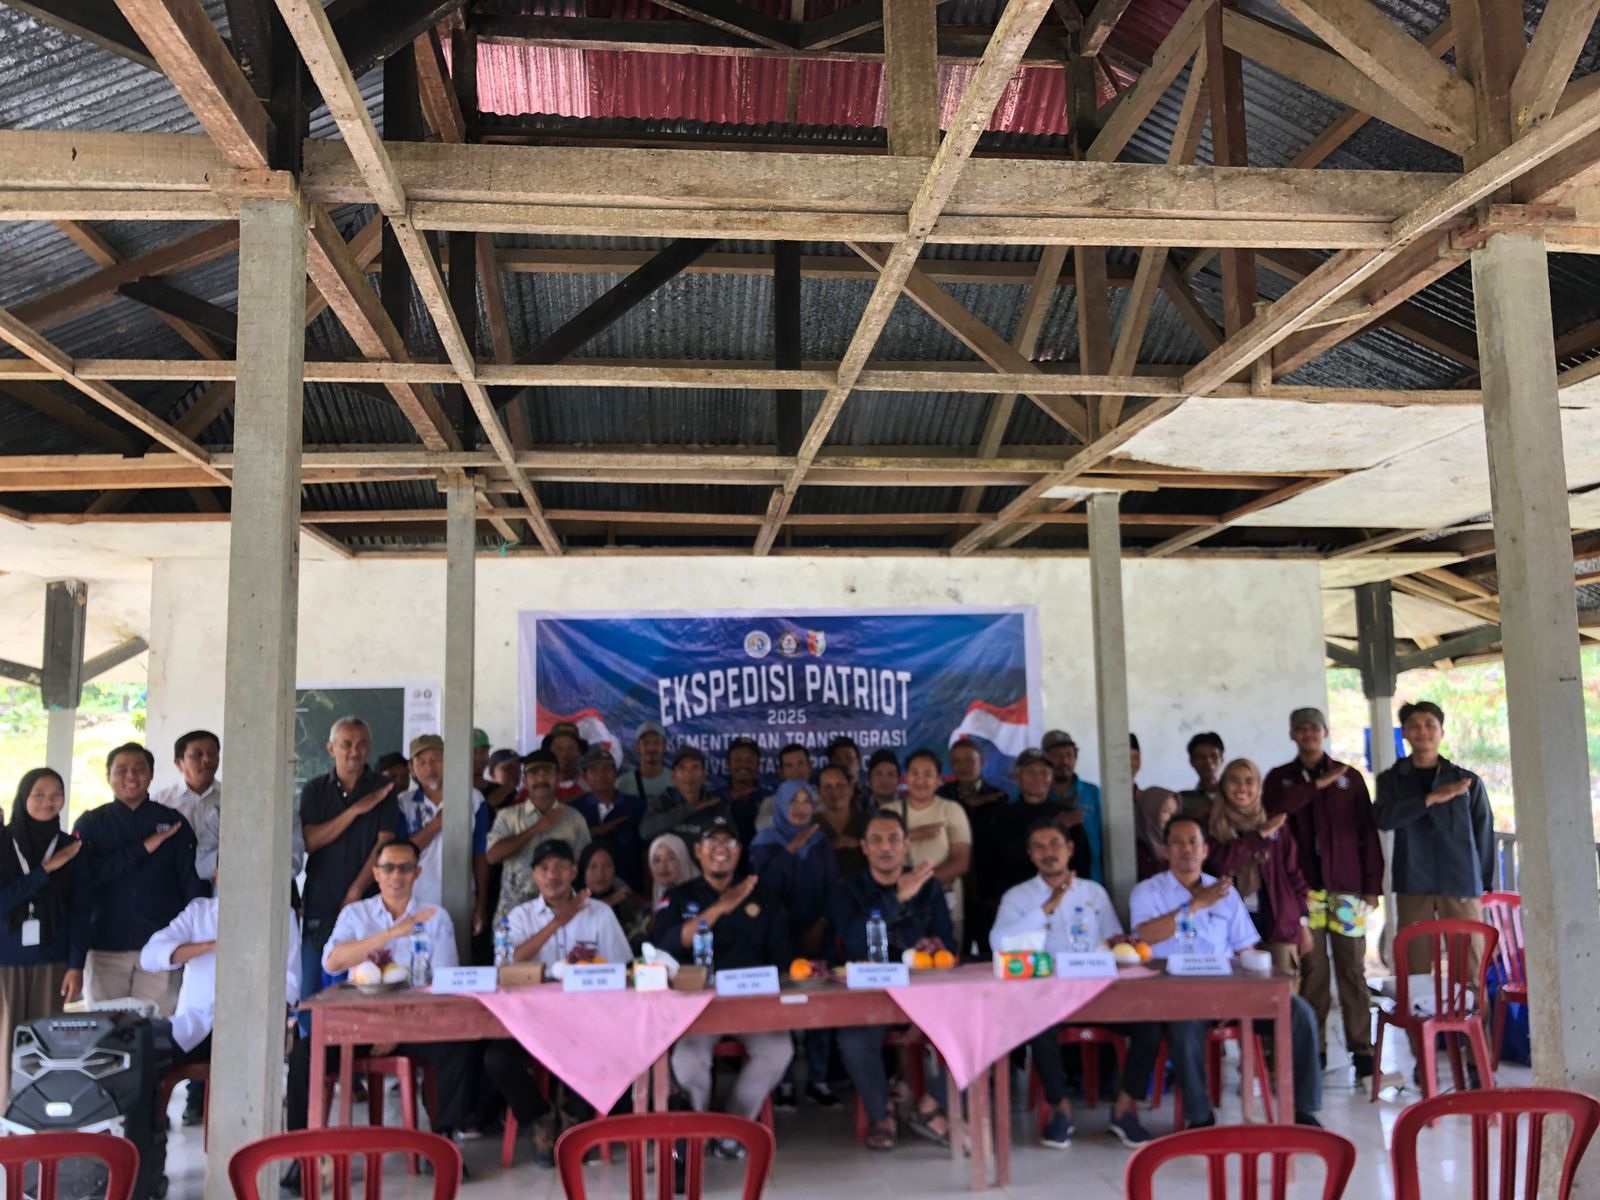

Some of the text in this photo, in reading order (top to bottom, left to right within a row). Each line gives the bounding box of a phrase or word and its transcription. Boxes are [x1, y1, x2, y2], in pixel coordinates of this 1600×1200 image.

[658, 664, 912, 727] EKSPEDISI PATRIOT
[767, 709, 807, 725] 2025
